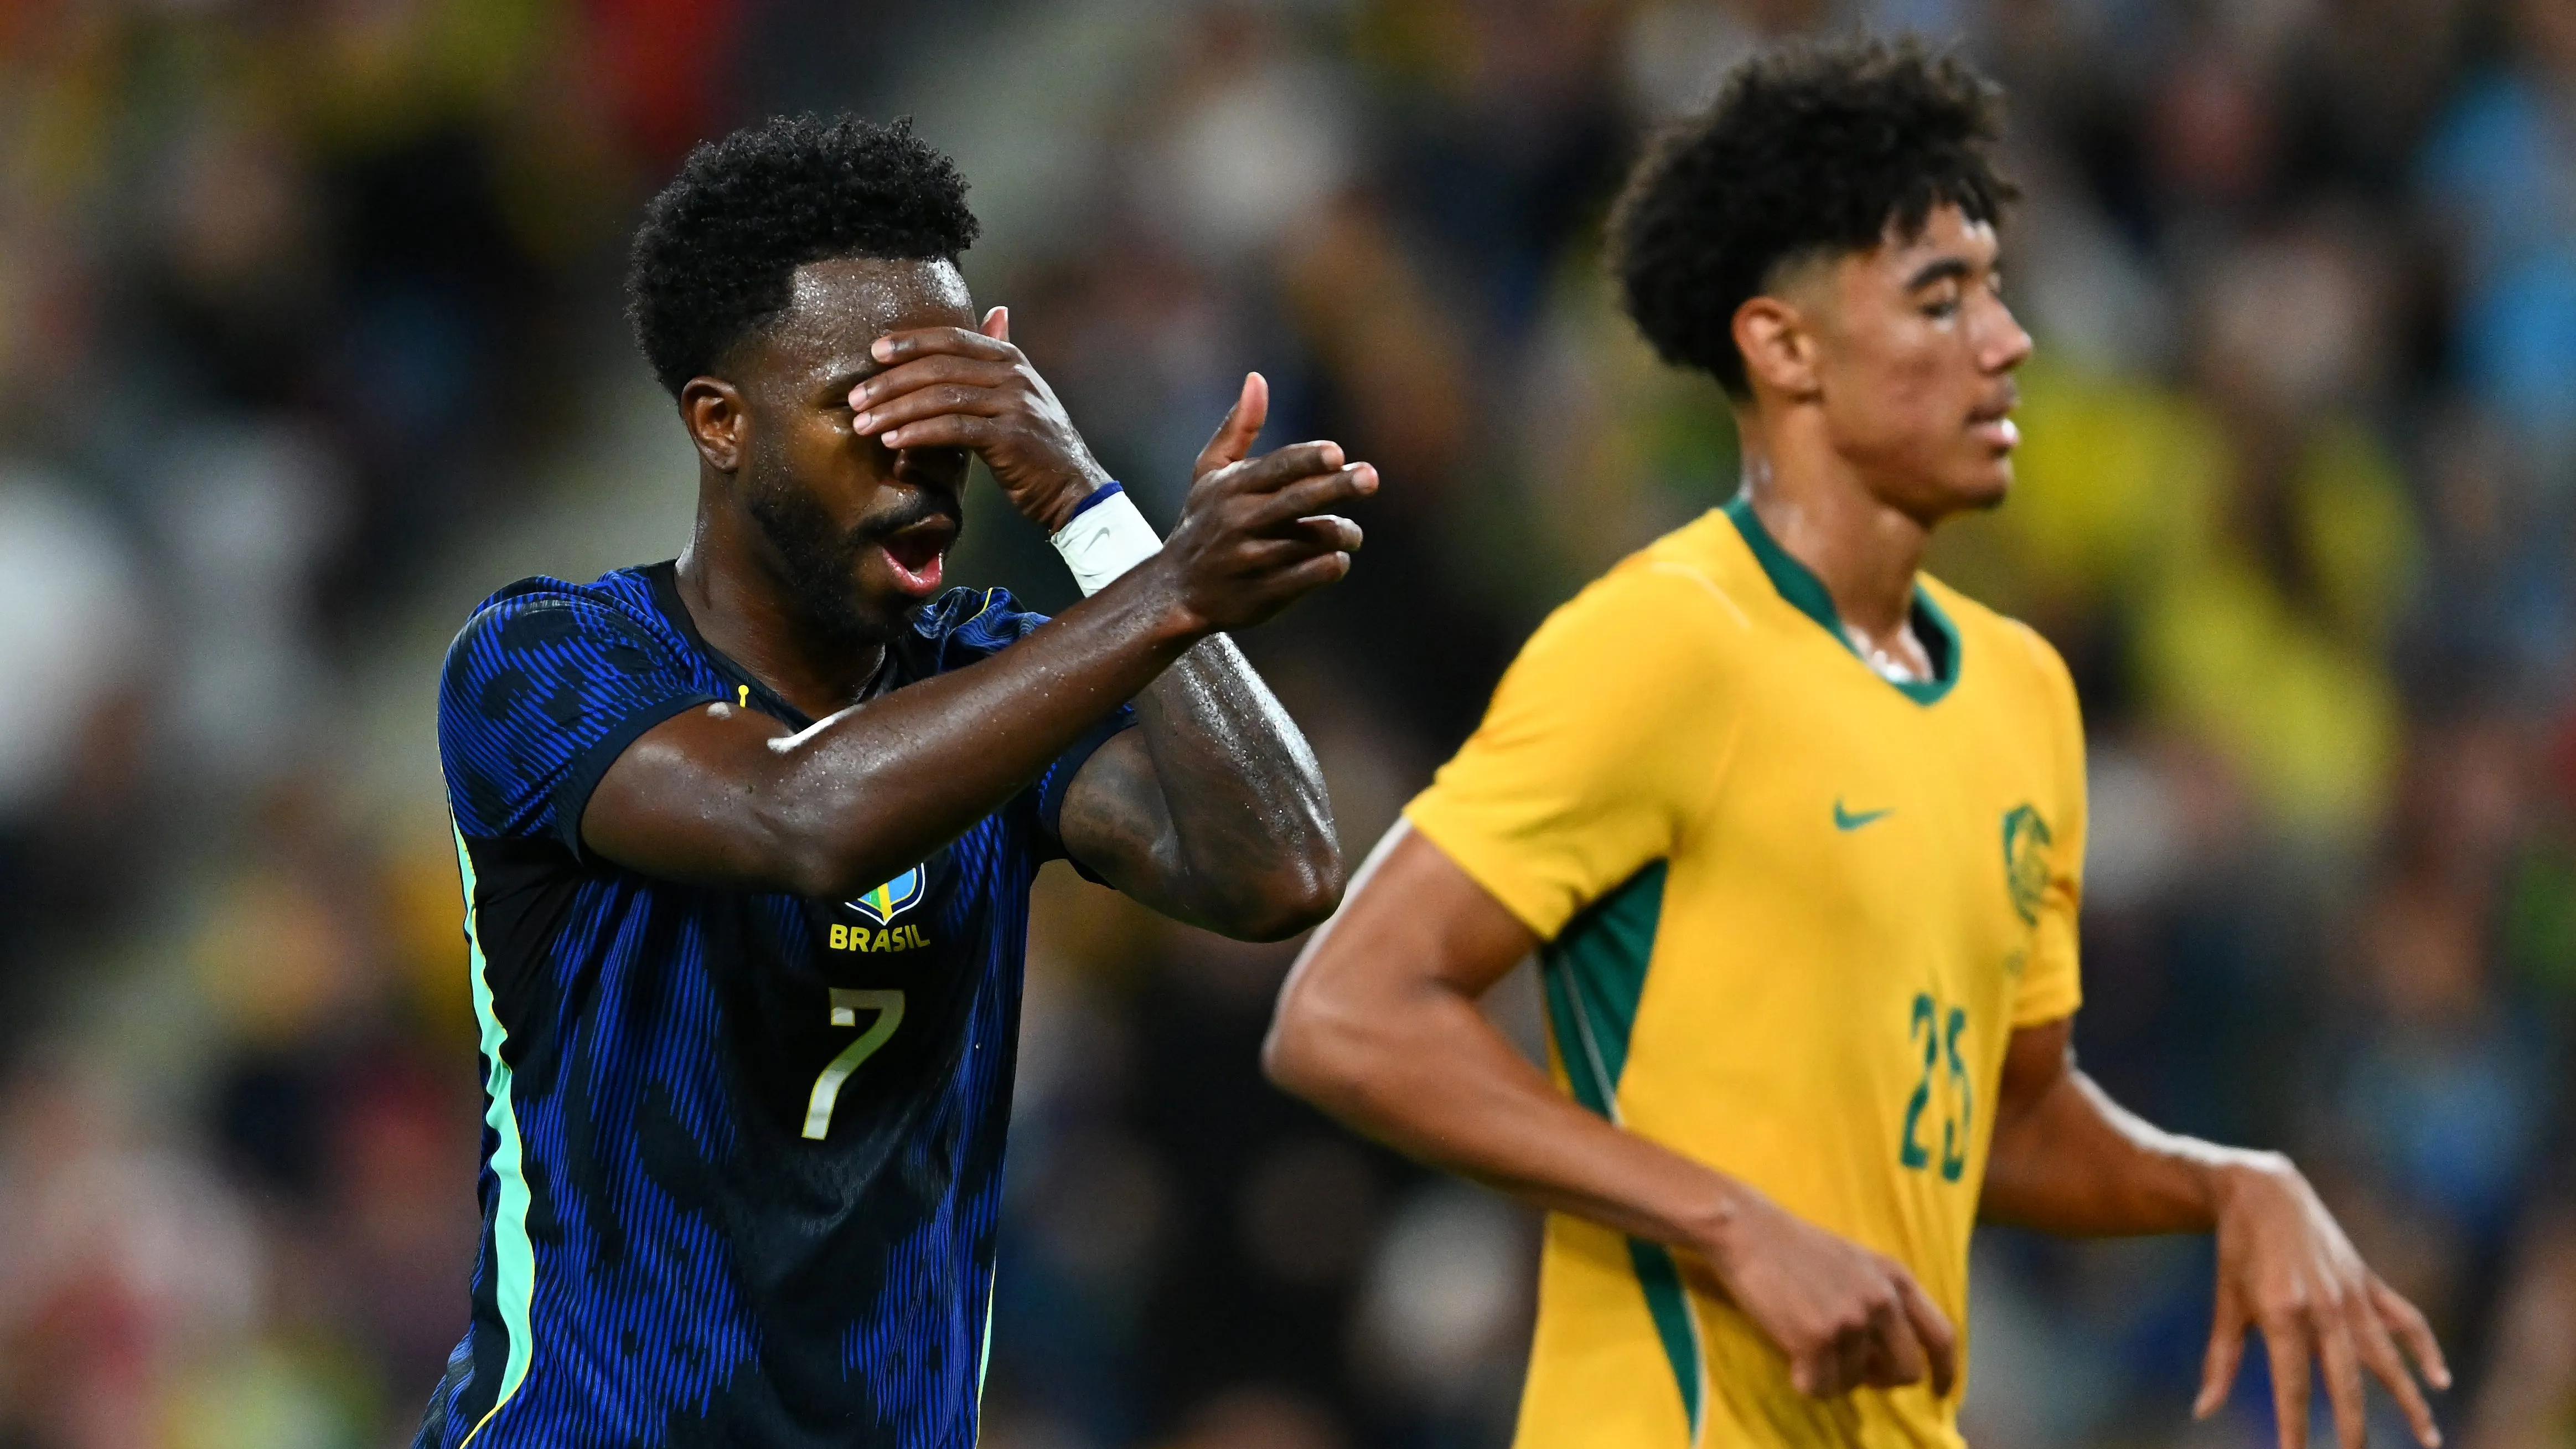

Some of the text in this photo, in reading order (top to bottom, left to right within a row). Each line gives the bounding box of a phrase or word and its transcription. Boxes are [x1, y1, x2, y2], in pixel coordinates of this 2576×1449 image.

[830, 923, 930, 952] BRASIL
[800, 987, 906, 1141] 7
[1899, 992, 1973, 1183] 25
